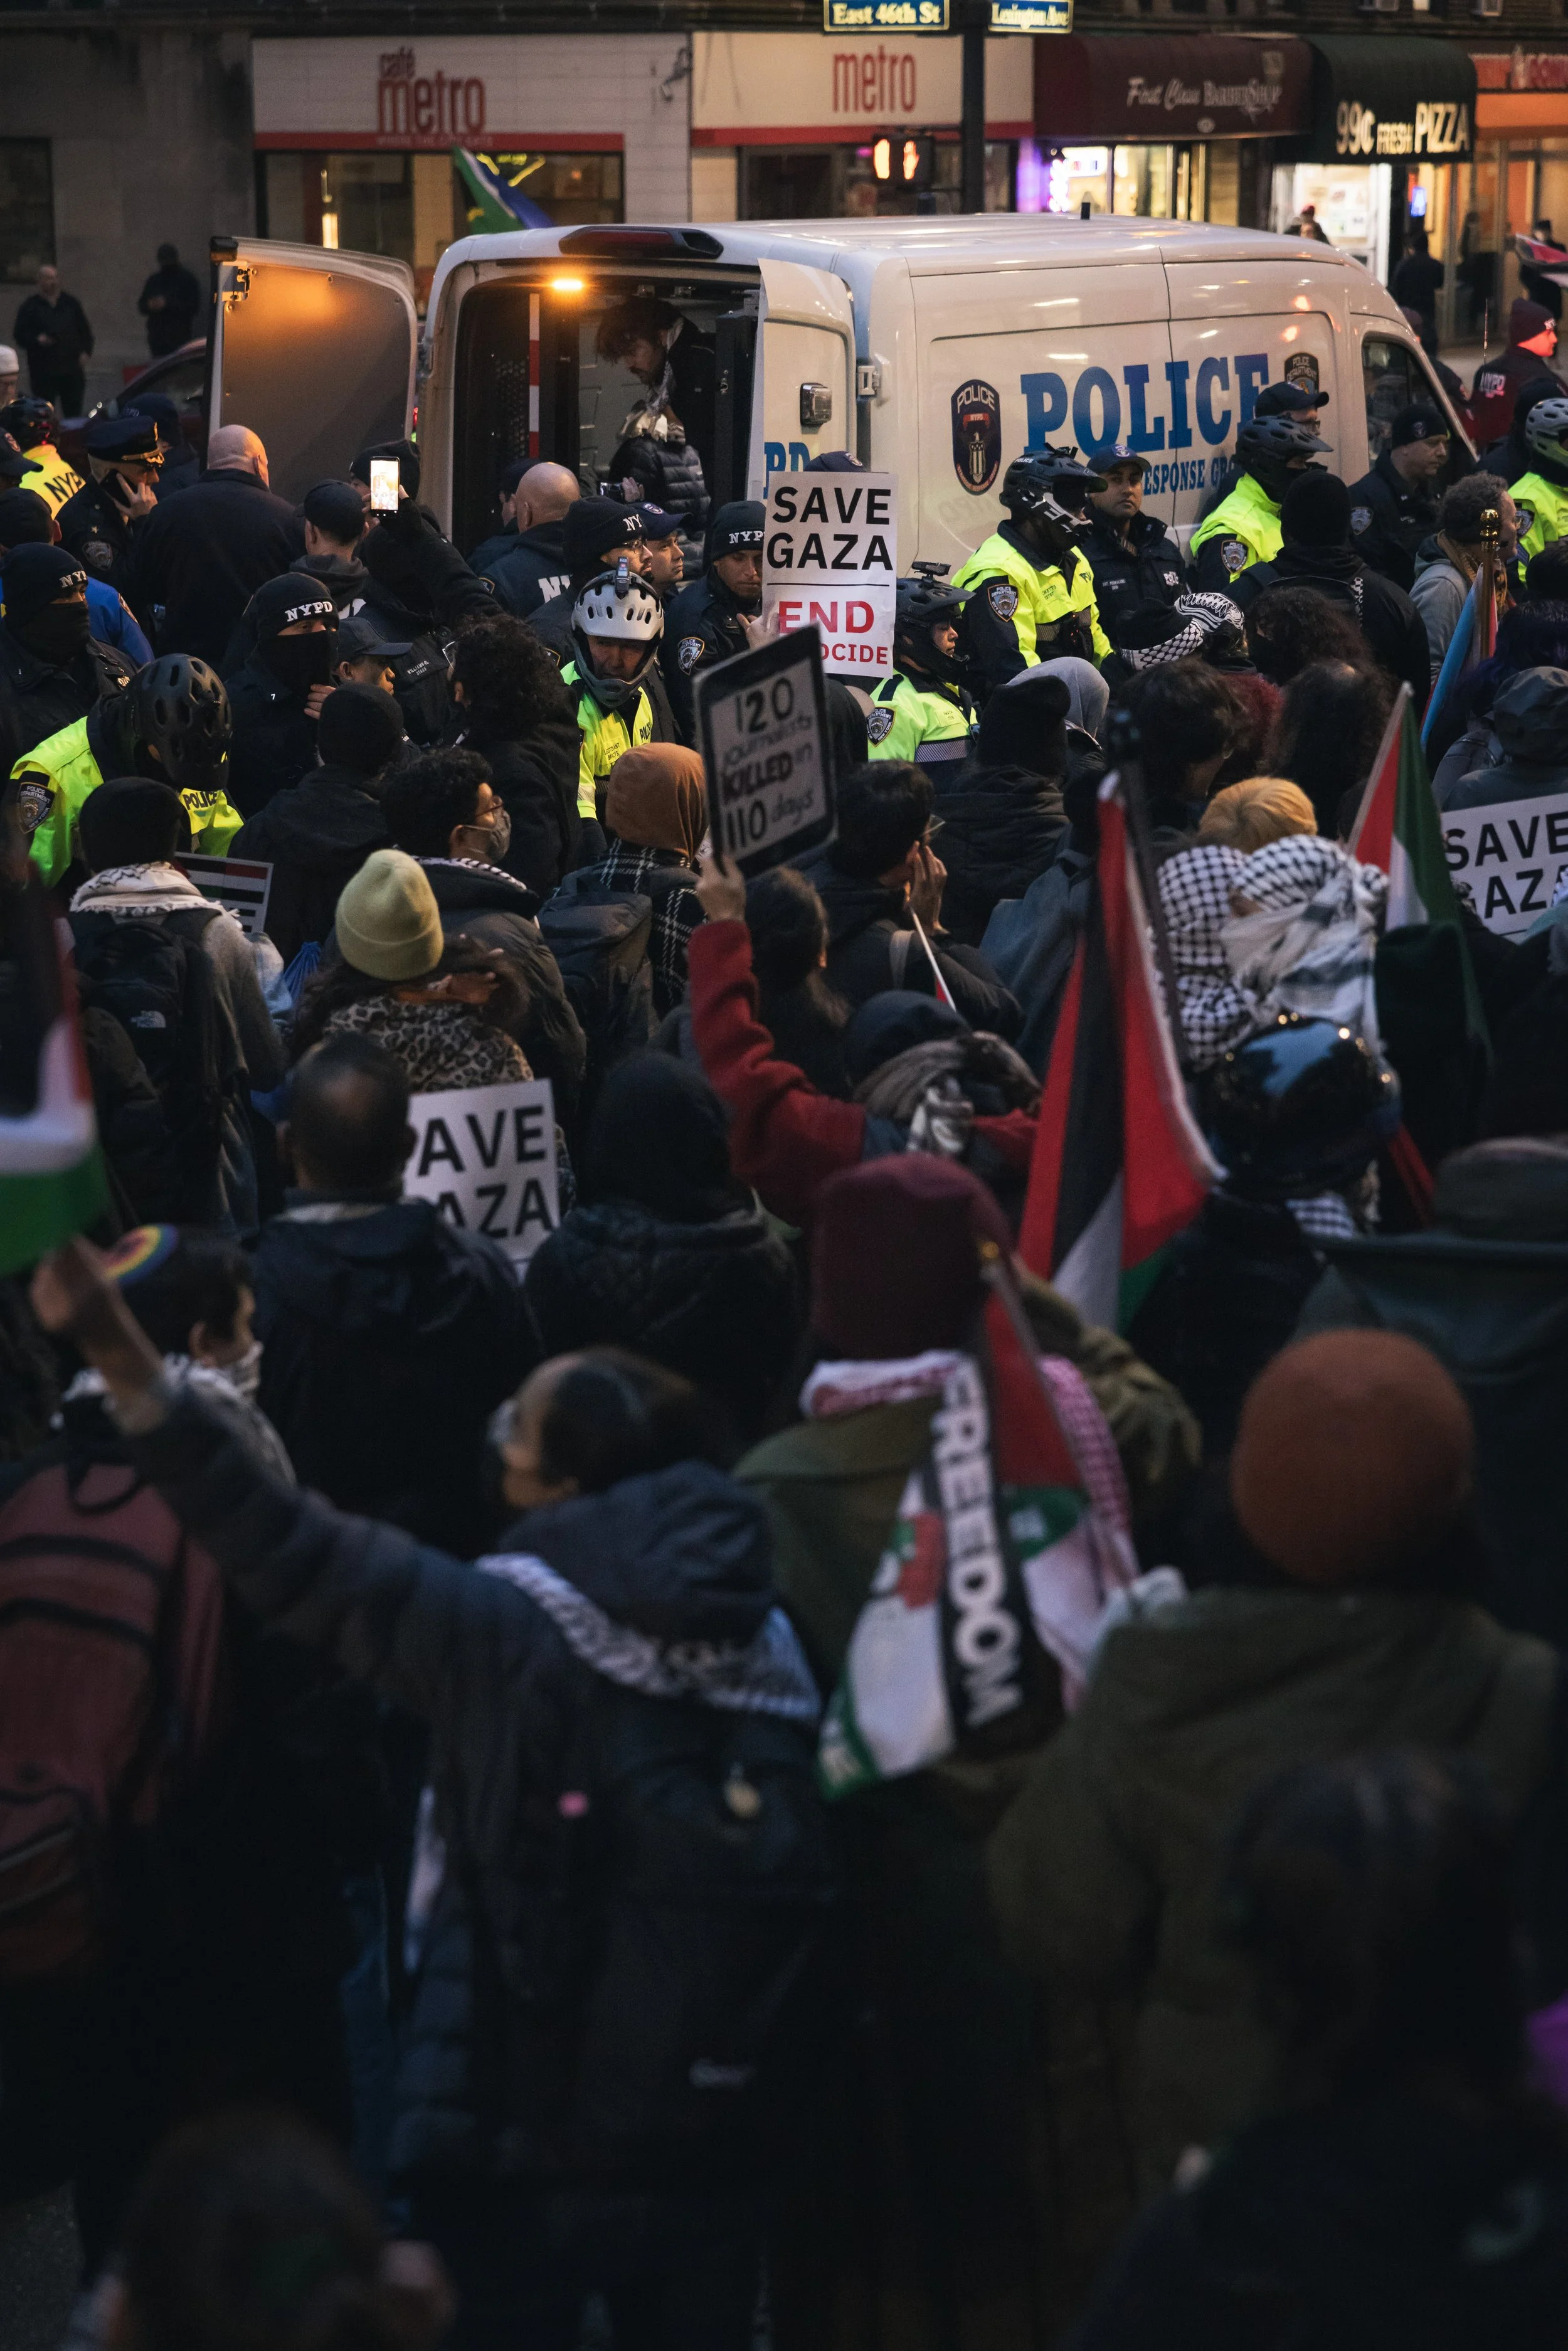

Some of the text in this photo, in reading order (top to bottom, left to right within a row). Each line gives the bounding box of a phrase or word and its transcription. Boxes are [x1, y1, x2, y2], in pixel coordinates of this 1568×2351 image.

[833, 3, 941, 24] East 46th St
[992, 3, 1069, 29] Lexington Ave
[832, 45, 917, 114] metro
[378, 70, 487, 134] metro
[1377, 122, 1414, 154] FRESH
[1414, 102, 1470, 154] PIZZA
[1293, 356, 1310, 367] POLICE
[956, 385, 995, 413] POLICE
[1020, 353, 1269, 459] POLICE
[1143, 459, 1205, 496] ESPONSE
[772, 486, 891, 525] SAVE
[729, 531, 764, 544] NYP
[767, 533, 894, 571] GAZA
[285, 601, 333, 622] NYPD
[778, 600, 874, 634] END
[821, 643, 888, 665] OCIDE
[735, 677, 793, 733] 120
[26, 786, 46, 795] POLICE
[723, 751, 793, 805] KILLED
[20, 791, 51, 804] DEPARTMENT
[38, 807, 50, 820] YORK
[183, 791, 217, 810] POLICE
[727, 788, 814, 852] 110 days
[1444, 811, 1568, 871] SAVE
[1460, 864, 1568, 920] AZ
[417, 1105, 546, 1177] AVE
[438, 1178, 553, 1239] AZA
[931, 1360, 1023, 1729] FREEDOM
